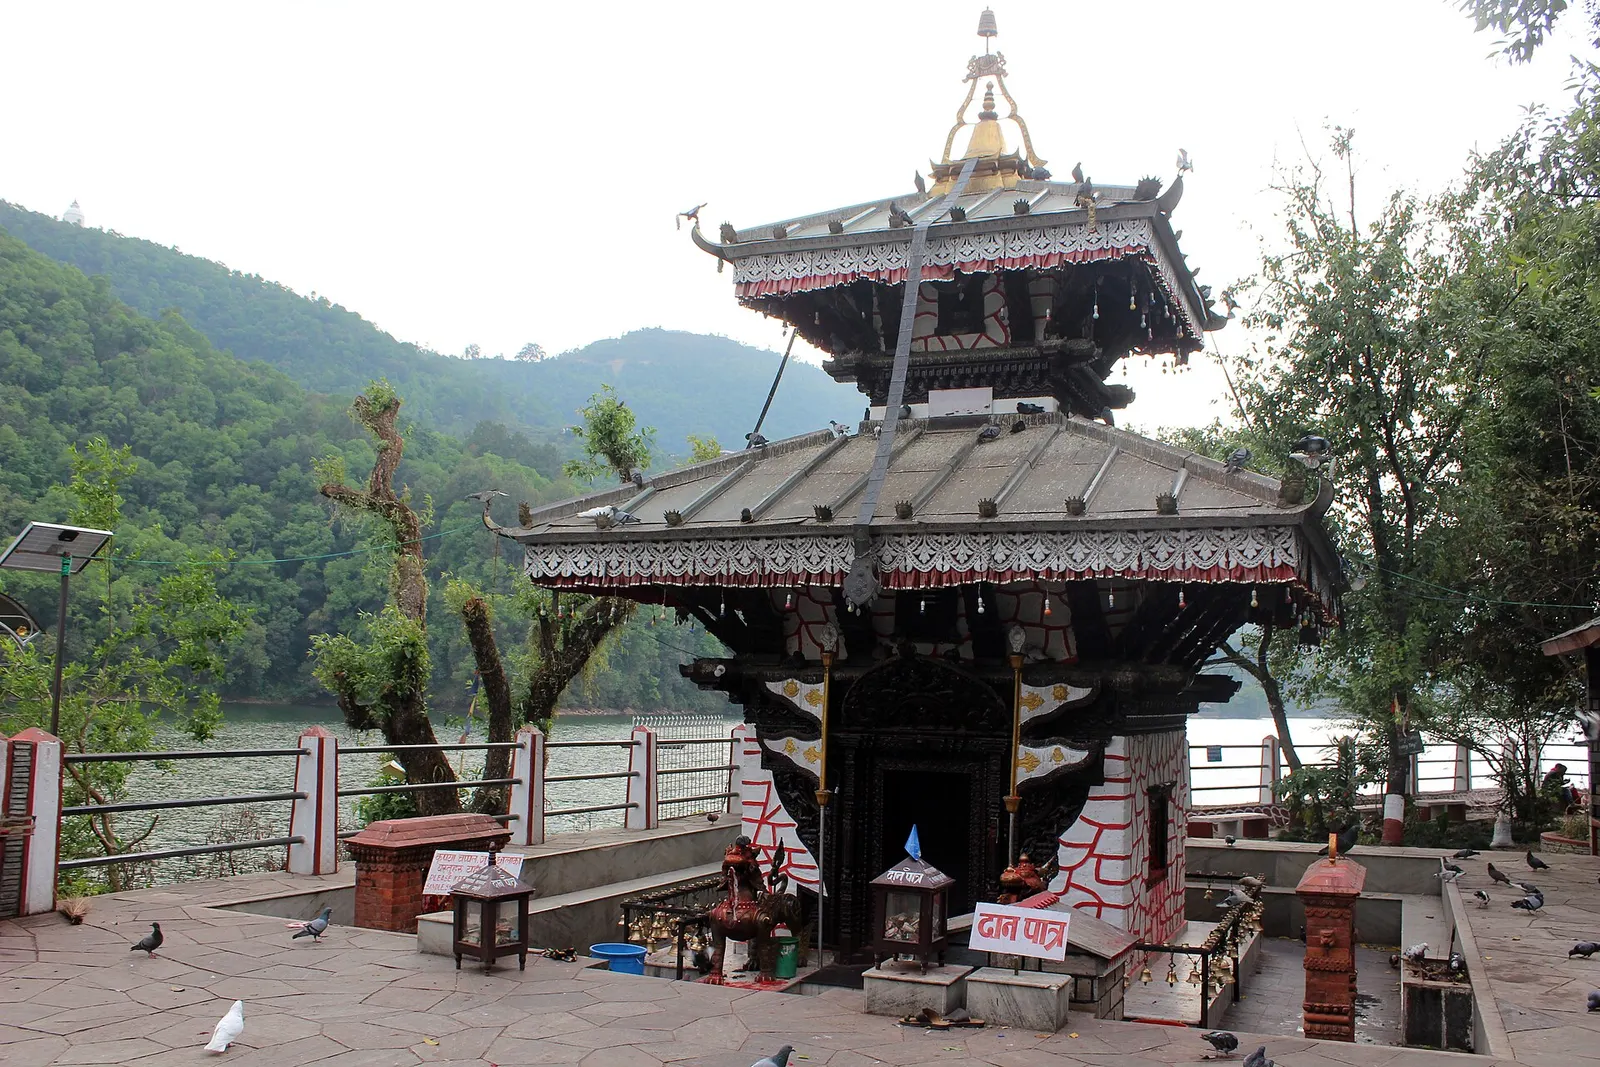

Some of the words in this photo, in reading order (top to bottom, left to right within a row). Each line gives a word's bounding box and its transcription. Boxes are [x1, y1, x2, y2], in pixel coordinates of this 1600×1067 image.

[430, 874, 452, 882] PLEASE
[977, 913, 1021, 941] दान
[1023, 917, 1067, 951] पात्र
